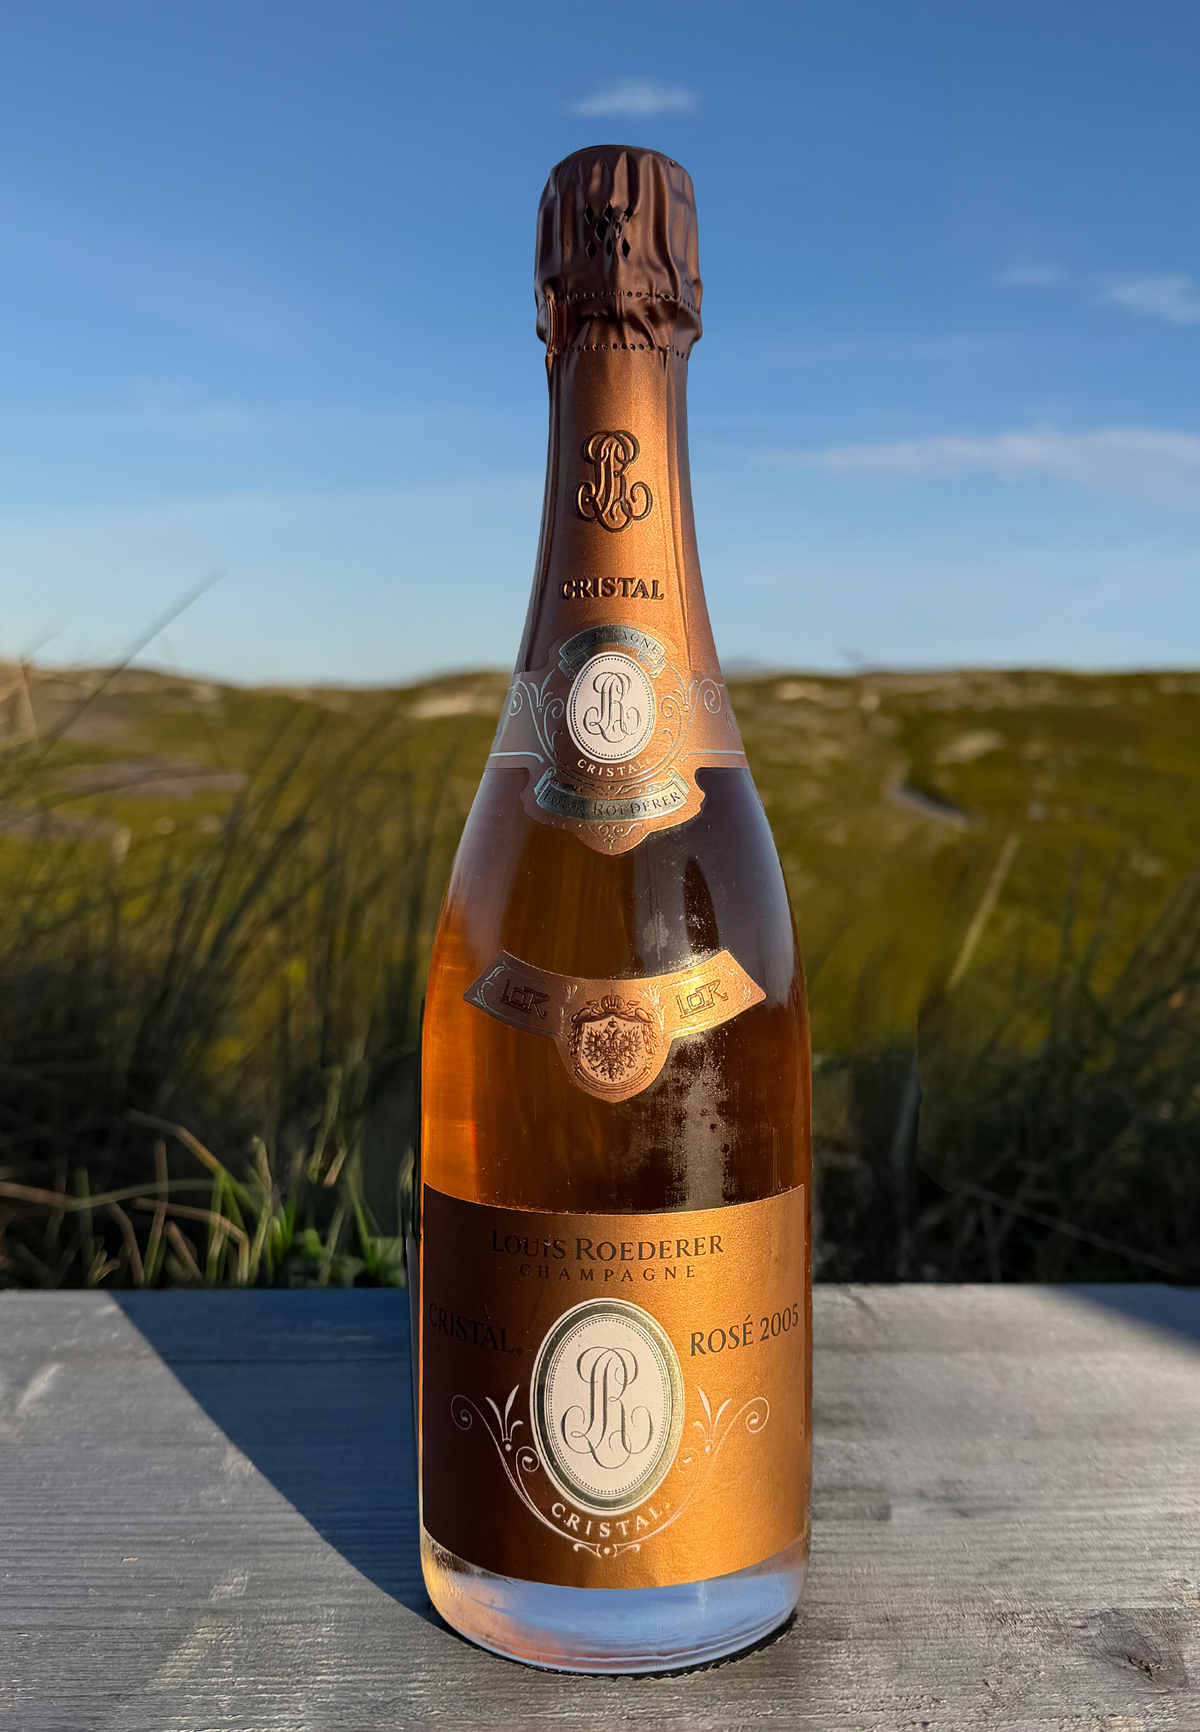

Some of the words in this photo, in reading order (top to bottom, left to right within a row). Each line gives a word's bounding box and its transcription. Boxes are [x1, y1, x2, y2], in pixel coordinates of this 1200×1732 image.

[561, 577, 664, 600] CRISTAL
[577, 758, 646, 777] CRISTAL
[593, 791, 682, 816] ROEDERER
[491, 1229, 566, 1260] LOUIS
[575, 1234, 724, 1262] ROEDERER
[519, 1263, 696, 1282] CHAMPAGNE
[690, 1314, 754, 1357] ROSÉ
[760, 1302, 799, 1343] 2005
[551, 1502, 663, 1538] CRISTAL
